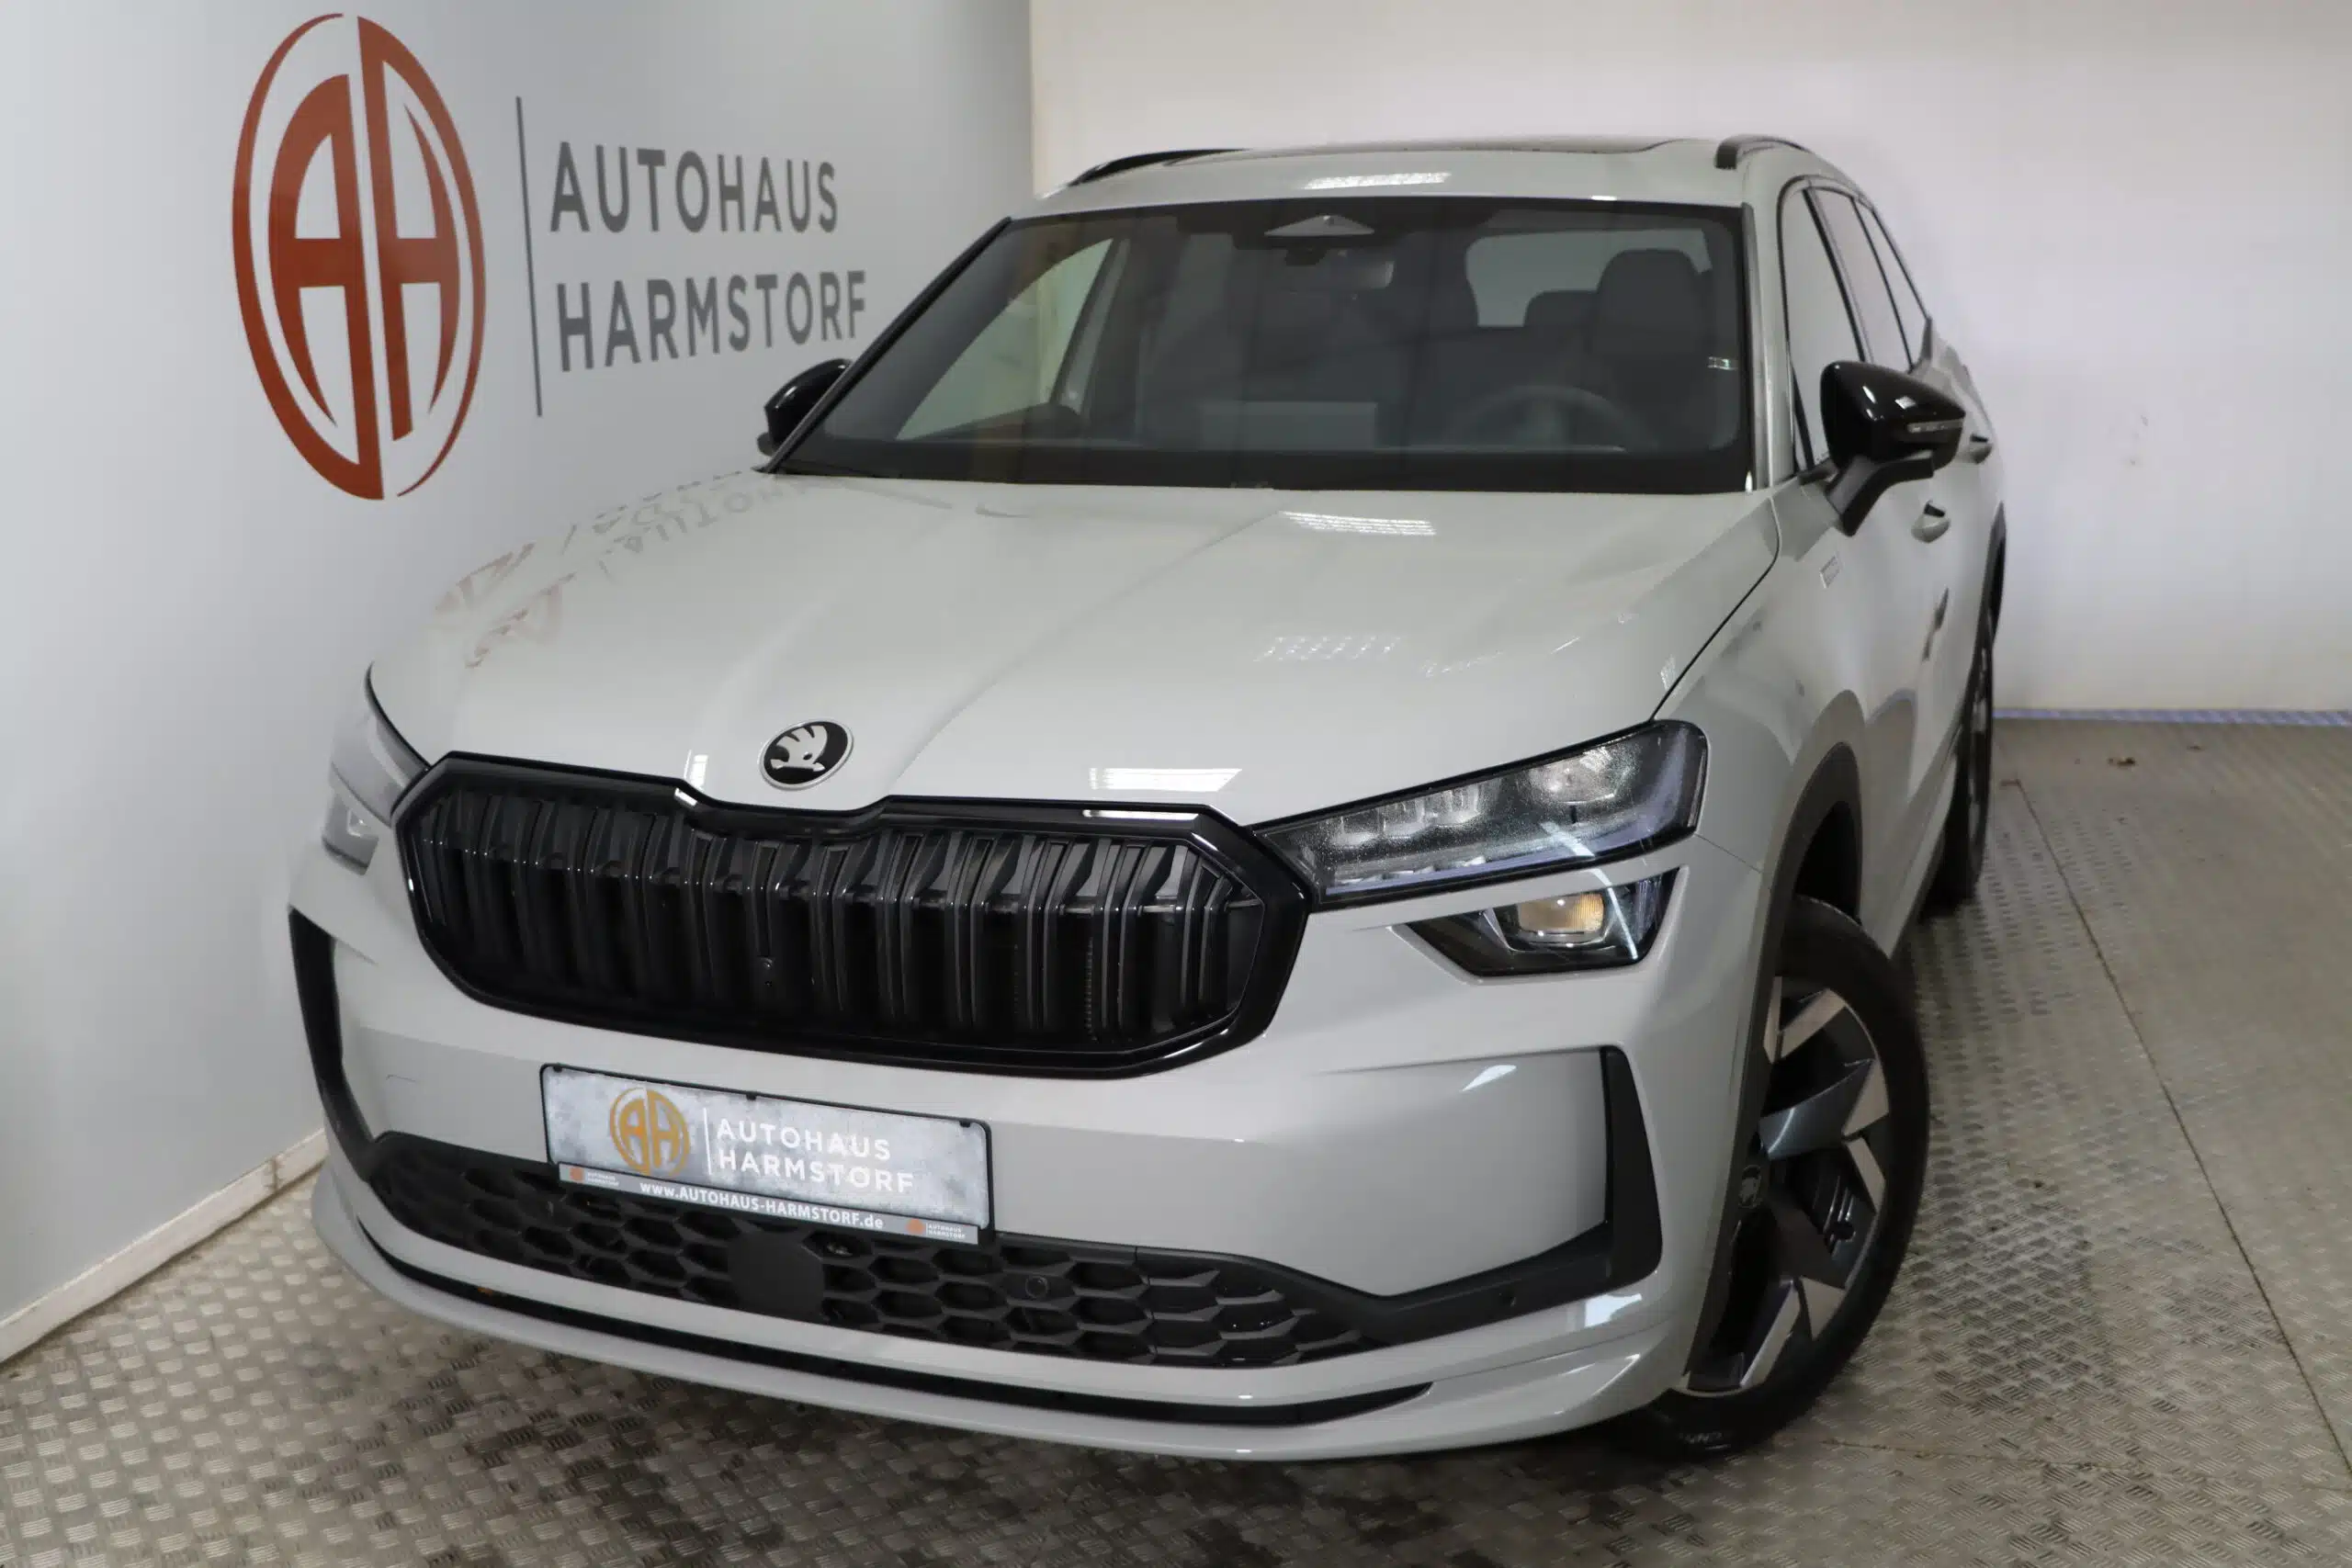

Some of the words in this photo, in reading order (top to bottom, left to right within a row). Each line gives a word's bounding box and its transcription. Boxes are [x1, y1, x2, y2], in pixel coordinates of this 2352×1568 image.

[550, 141, 838, 233] AUTOHAUS
[556, 270, 866, 372] HARMSTORF
[716, 1118, 891, 1161] AUTOHAUS
[718, 1149, 914, 1194] HARMSTORF
[639, 1182, 884, 1229] www.AUTOHAUS-HARMSTORF.de
